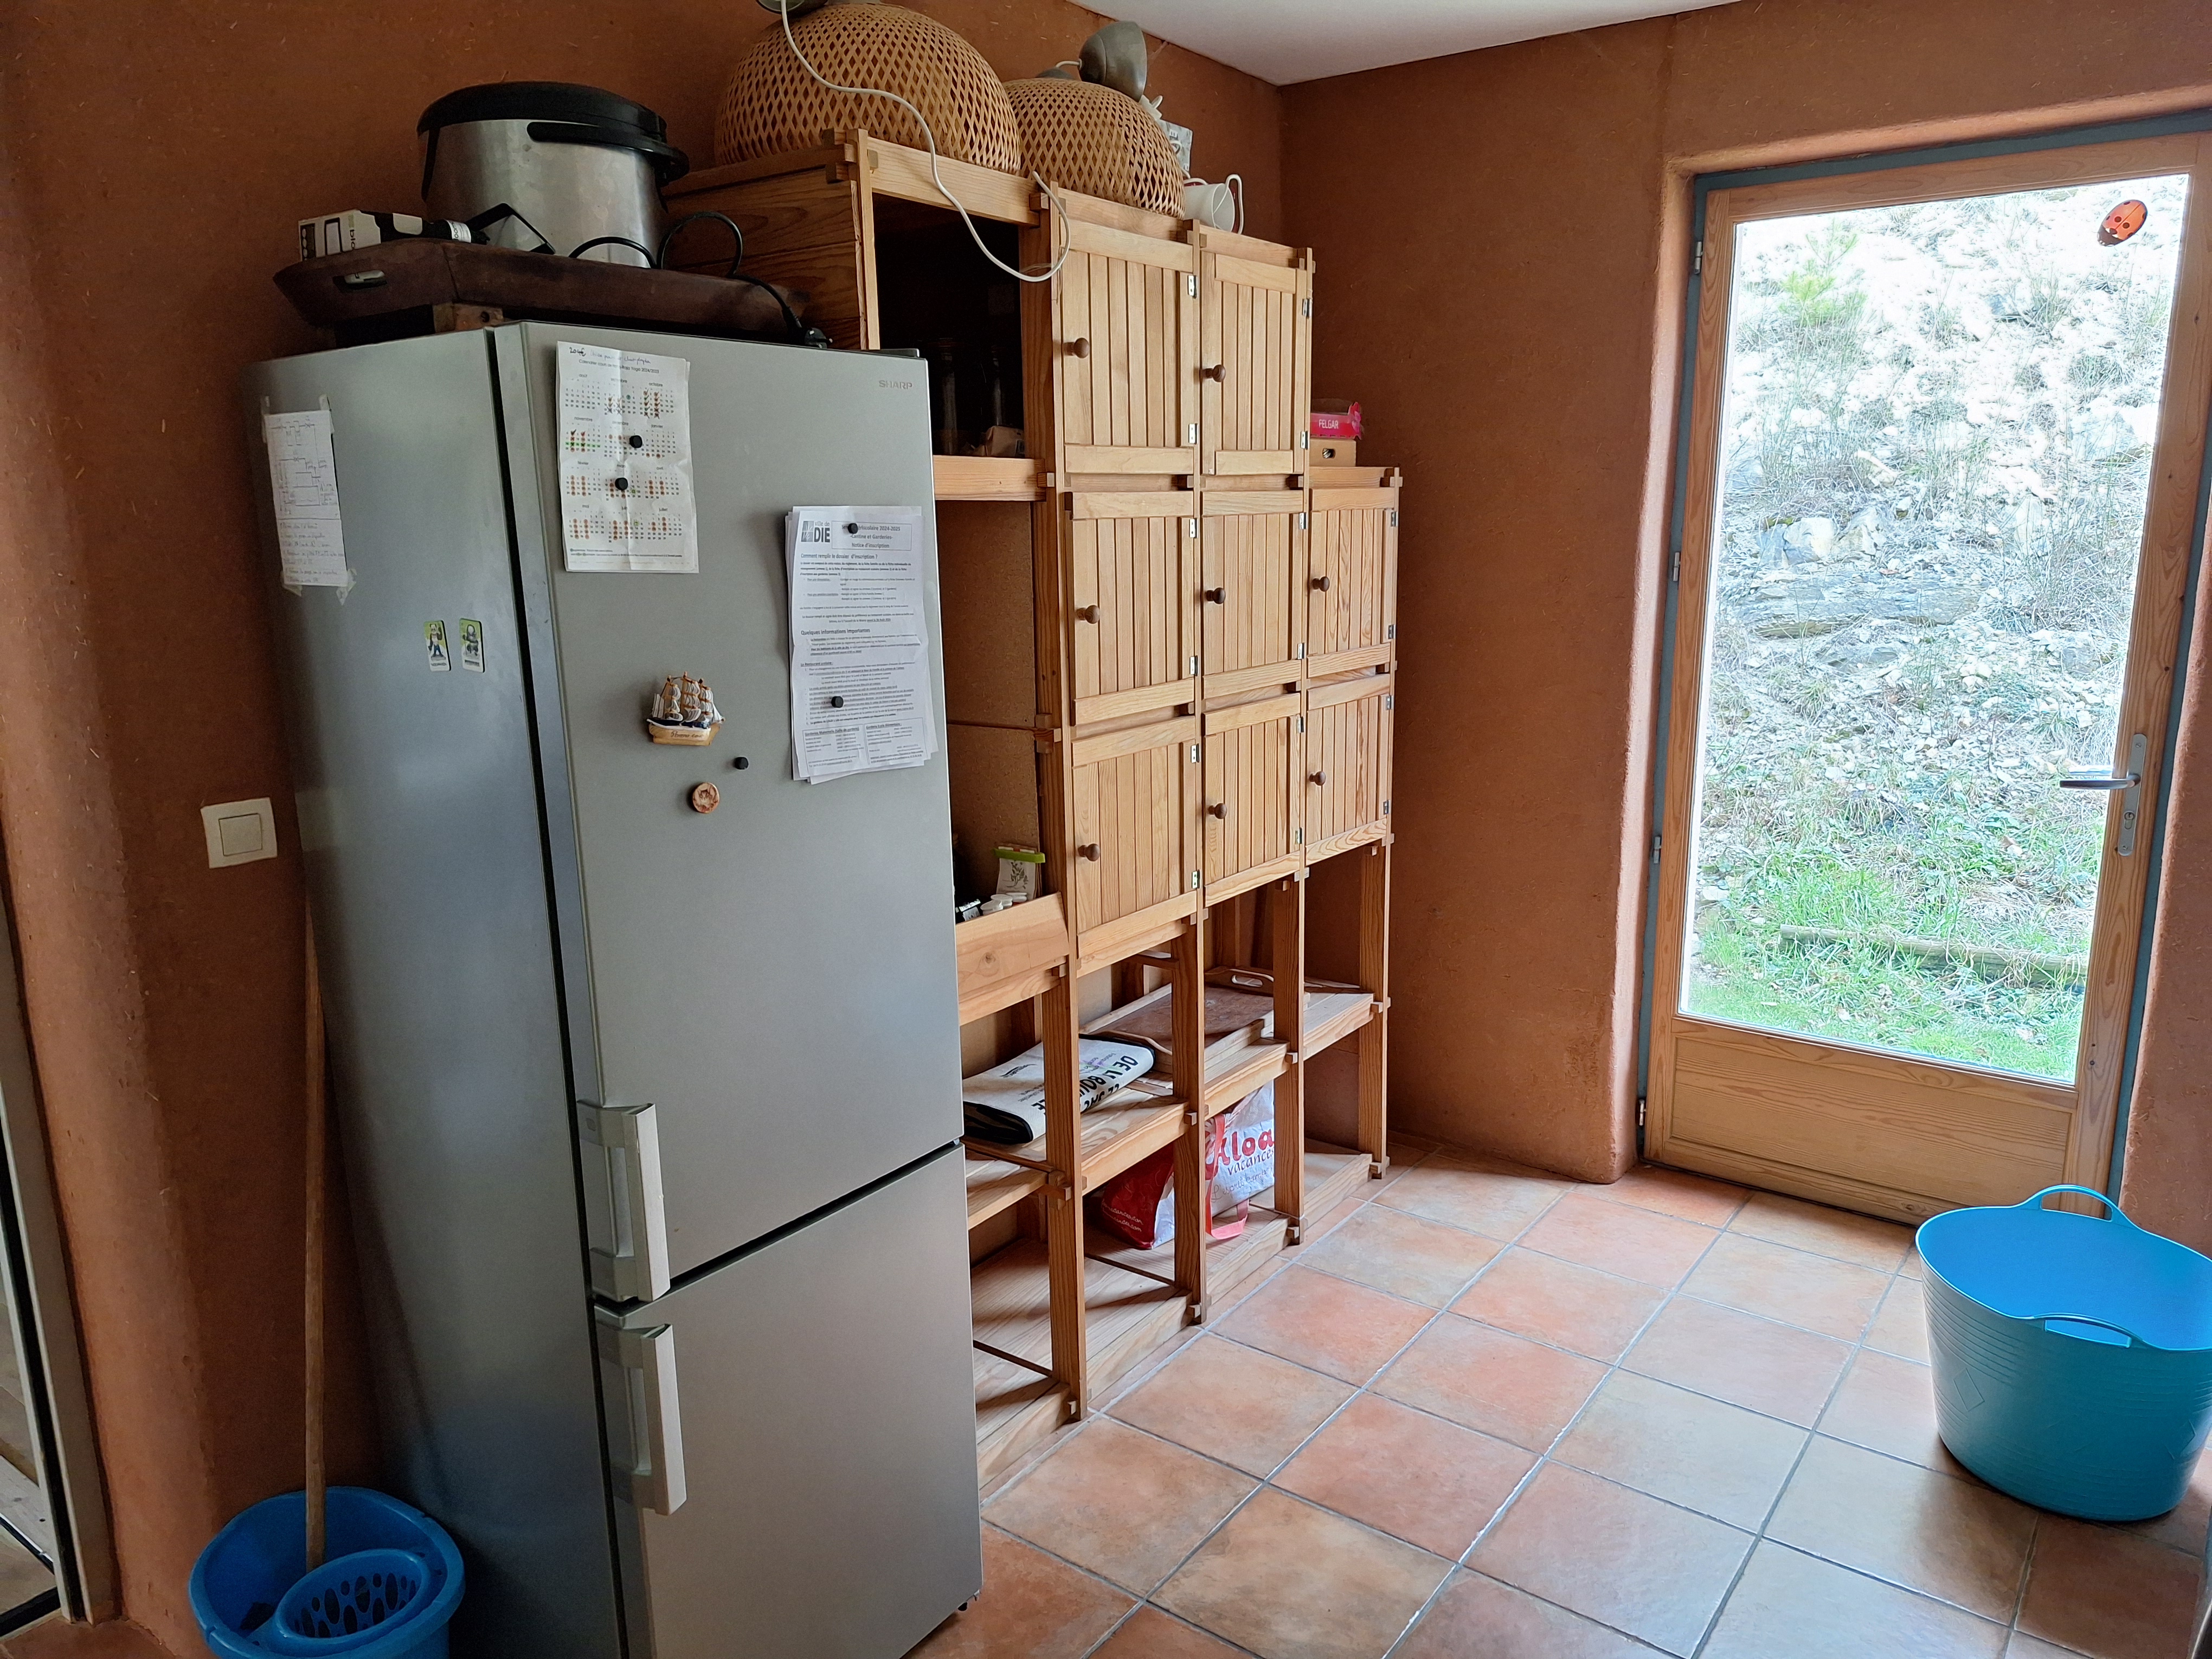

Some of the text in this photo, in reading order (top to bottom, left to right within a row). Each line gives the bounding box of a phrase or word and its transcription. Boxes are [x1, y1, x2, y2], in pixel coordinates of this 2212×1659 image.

[879, 380, 913, 390] SHARP
[814, 528, 831, 543] DIE
[1113, 1055, 1139, 1072] DE
